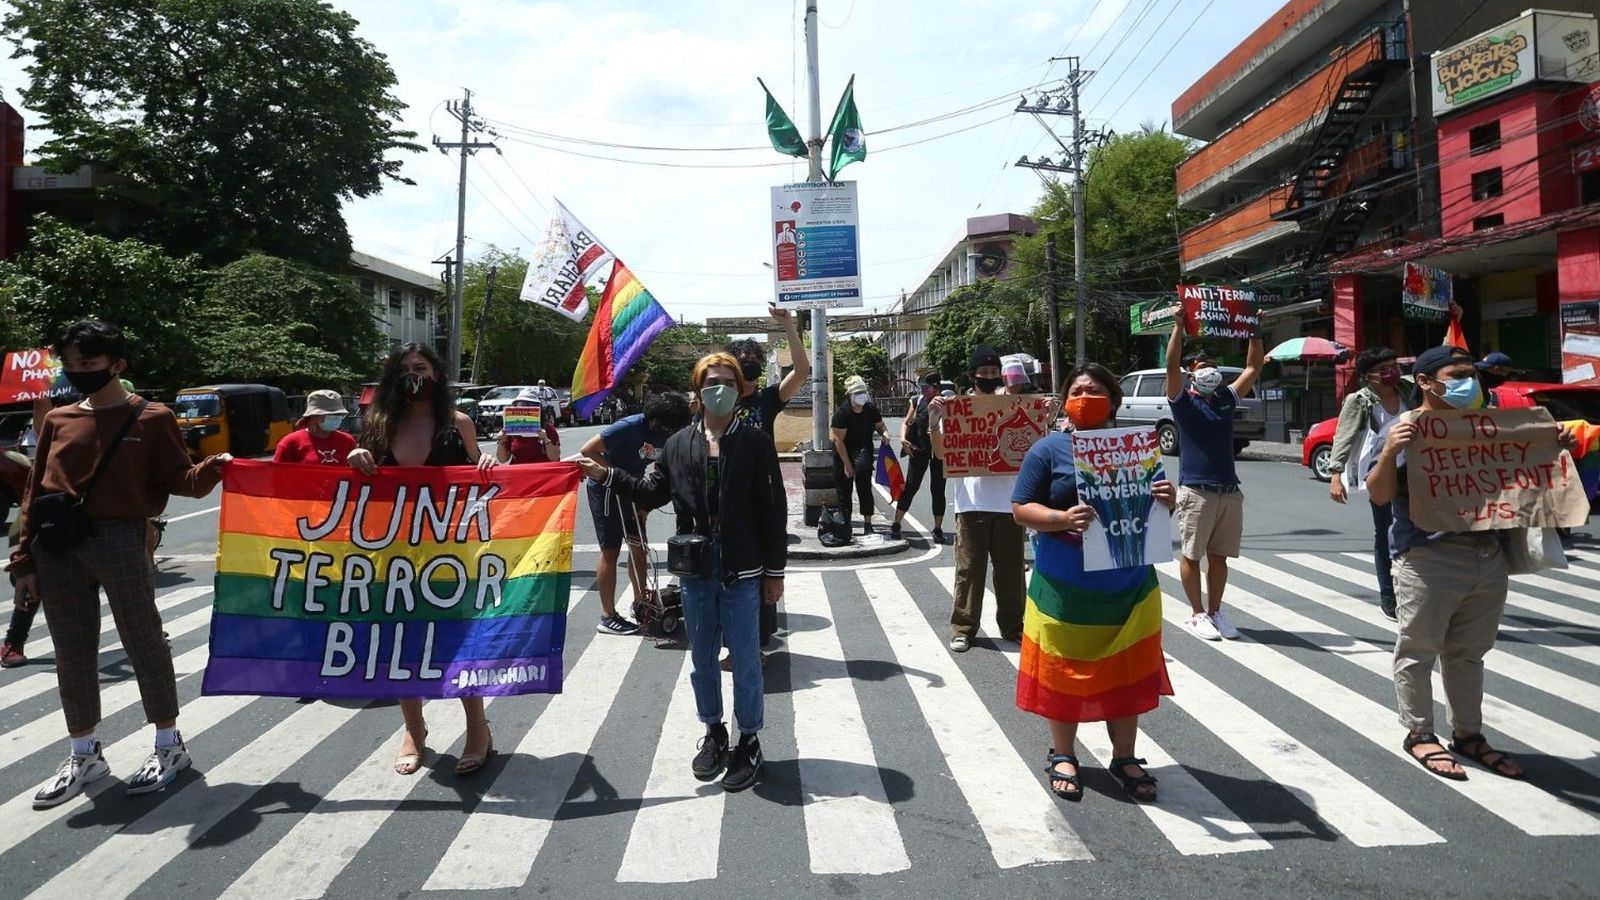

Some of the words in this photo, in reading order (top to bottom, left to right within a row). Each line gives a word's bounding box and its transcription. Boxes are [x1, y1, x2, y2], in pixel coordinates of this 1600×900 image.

[1184, 287, 1256, 302] ANTI-TERROR
[1200, 300, 1229, 313] BILL,
[1194, 311, 1231, 324] SASHAY
[1234, 313, 1259, 325] AWAY
[11, 351, 41, 371] NO
[22, 366, 63, 382] PHASE
[944, 398, 973, 417] TAE
[943, 419, 961, 434] BA
[1414, 416, 1448, 439] NO
[1462, 414, 1498, 439] TO
[1076, 435, 1126, 453] BAKLA
[943, 452, 967, 468] TAE
[1420, 441, 1532, 474] JEEPNEY
[1093, 469, 1112, 485] SA
[1084, 481, 1153, 501] IMBYERN
[296, 480, 501, 549] JUNK
[270, 548, 506, 615] TERROR
[319, 621, 443, 681] BILL
